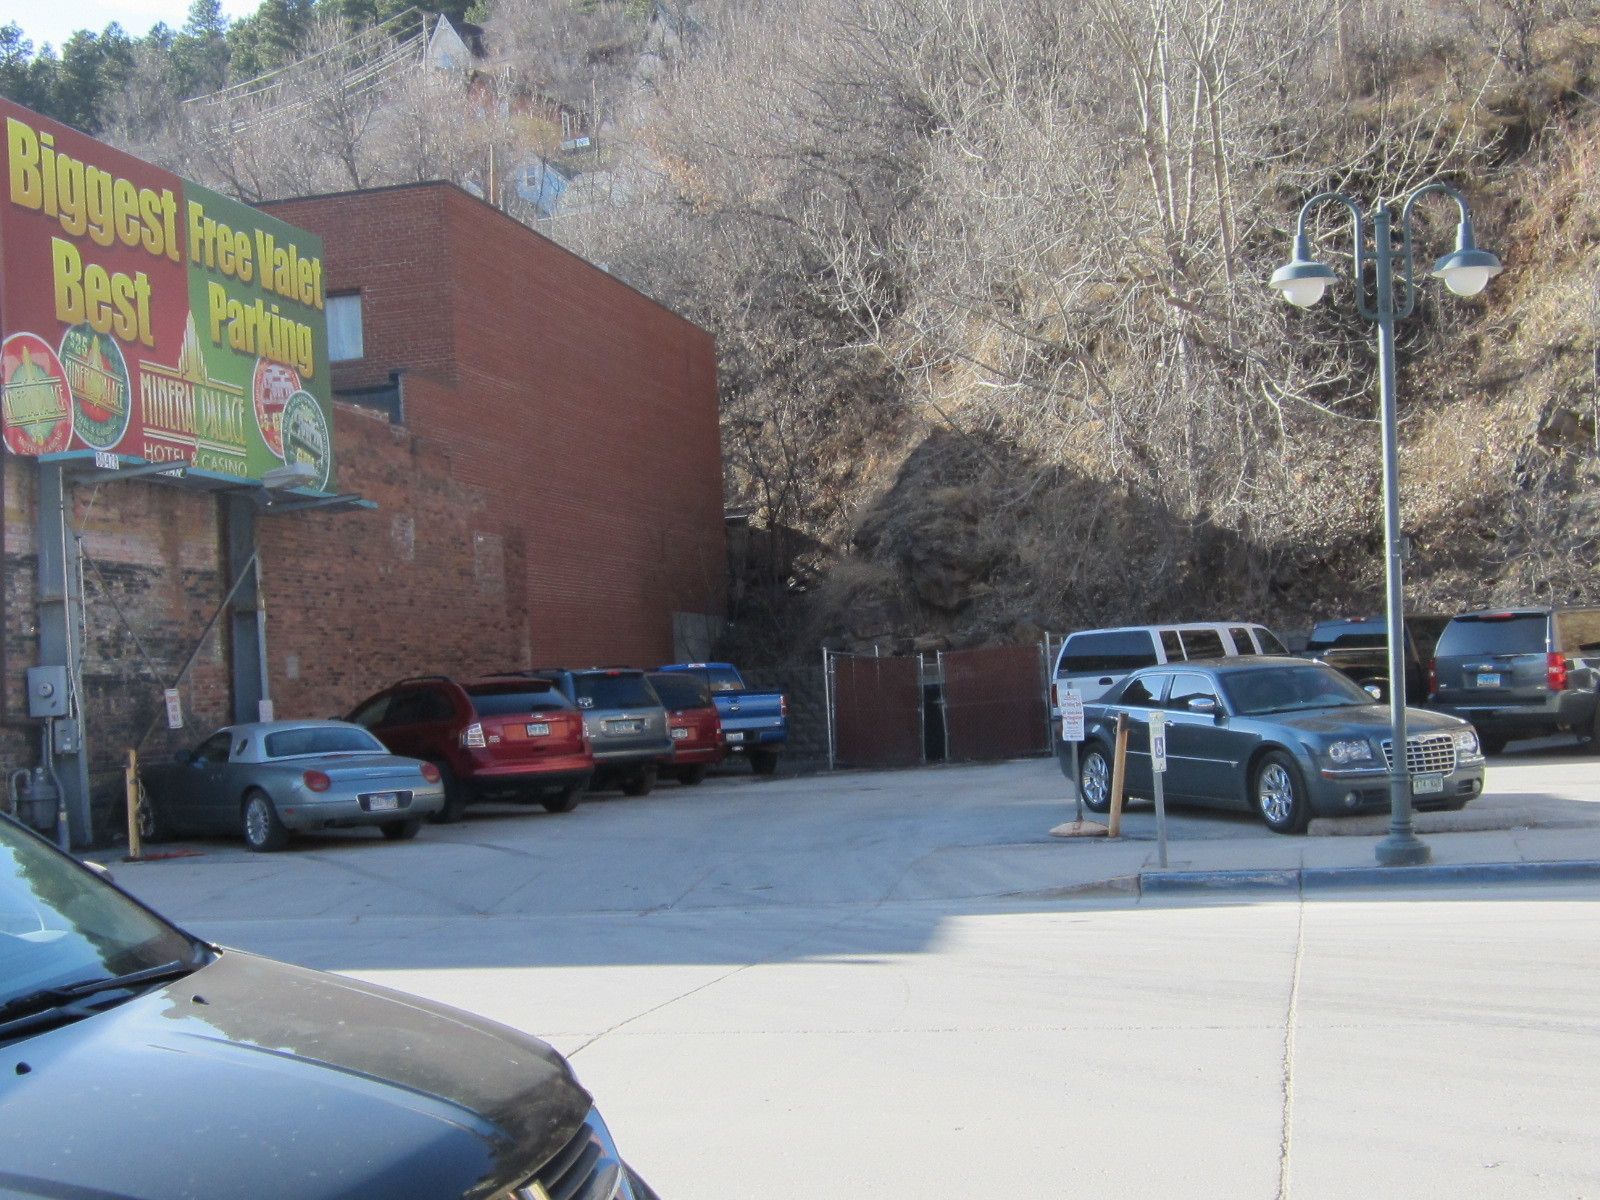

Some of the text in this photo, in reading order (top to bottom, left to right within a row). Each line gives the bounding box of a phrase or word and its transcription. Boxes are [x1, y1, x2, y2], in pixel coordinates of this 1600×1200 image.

[7, 117, 180, 262] Biggest
[51, 237, 155, 347] Best
[187, 200, 323, 310] Free Valet
[208, 281, 314, 379] Parking
[140, 372, 198, 434] MINERAL
[202, 388, 246, 445] PALACE
[144, 442, 184, 463] HOTEL
[191, 451, 199, 467] &
[202, 454, 247, 476] CASINO
